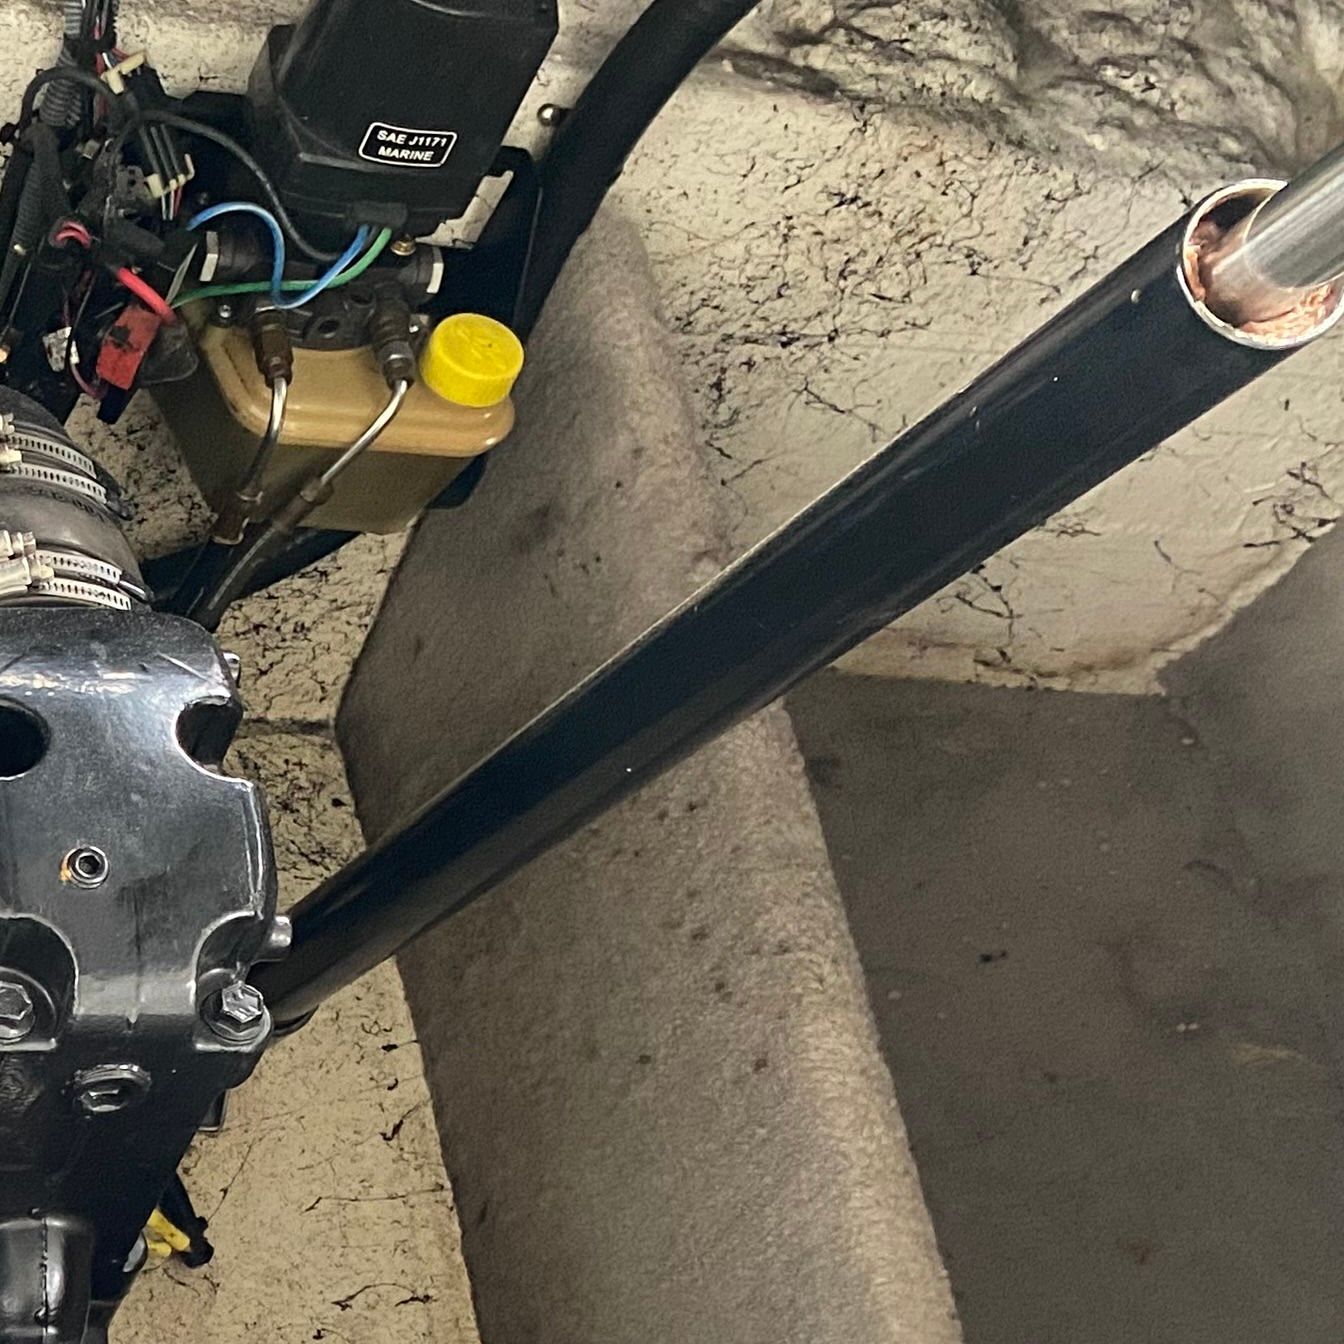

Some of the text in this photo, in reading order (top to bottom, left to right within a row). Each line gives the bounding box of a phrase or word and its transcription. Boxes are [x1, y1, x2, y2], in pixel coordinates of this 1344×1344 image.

[376, 130, 448, 147] SAE J1171
[378, 146, 434, 161] MARINE
